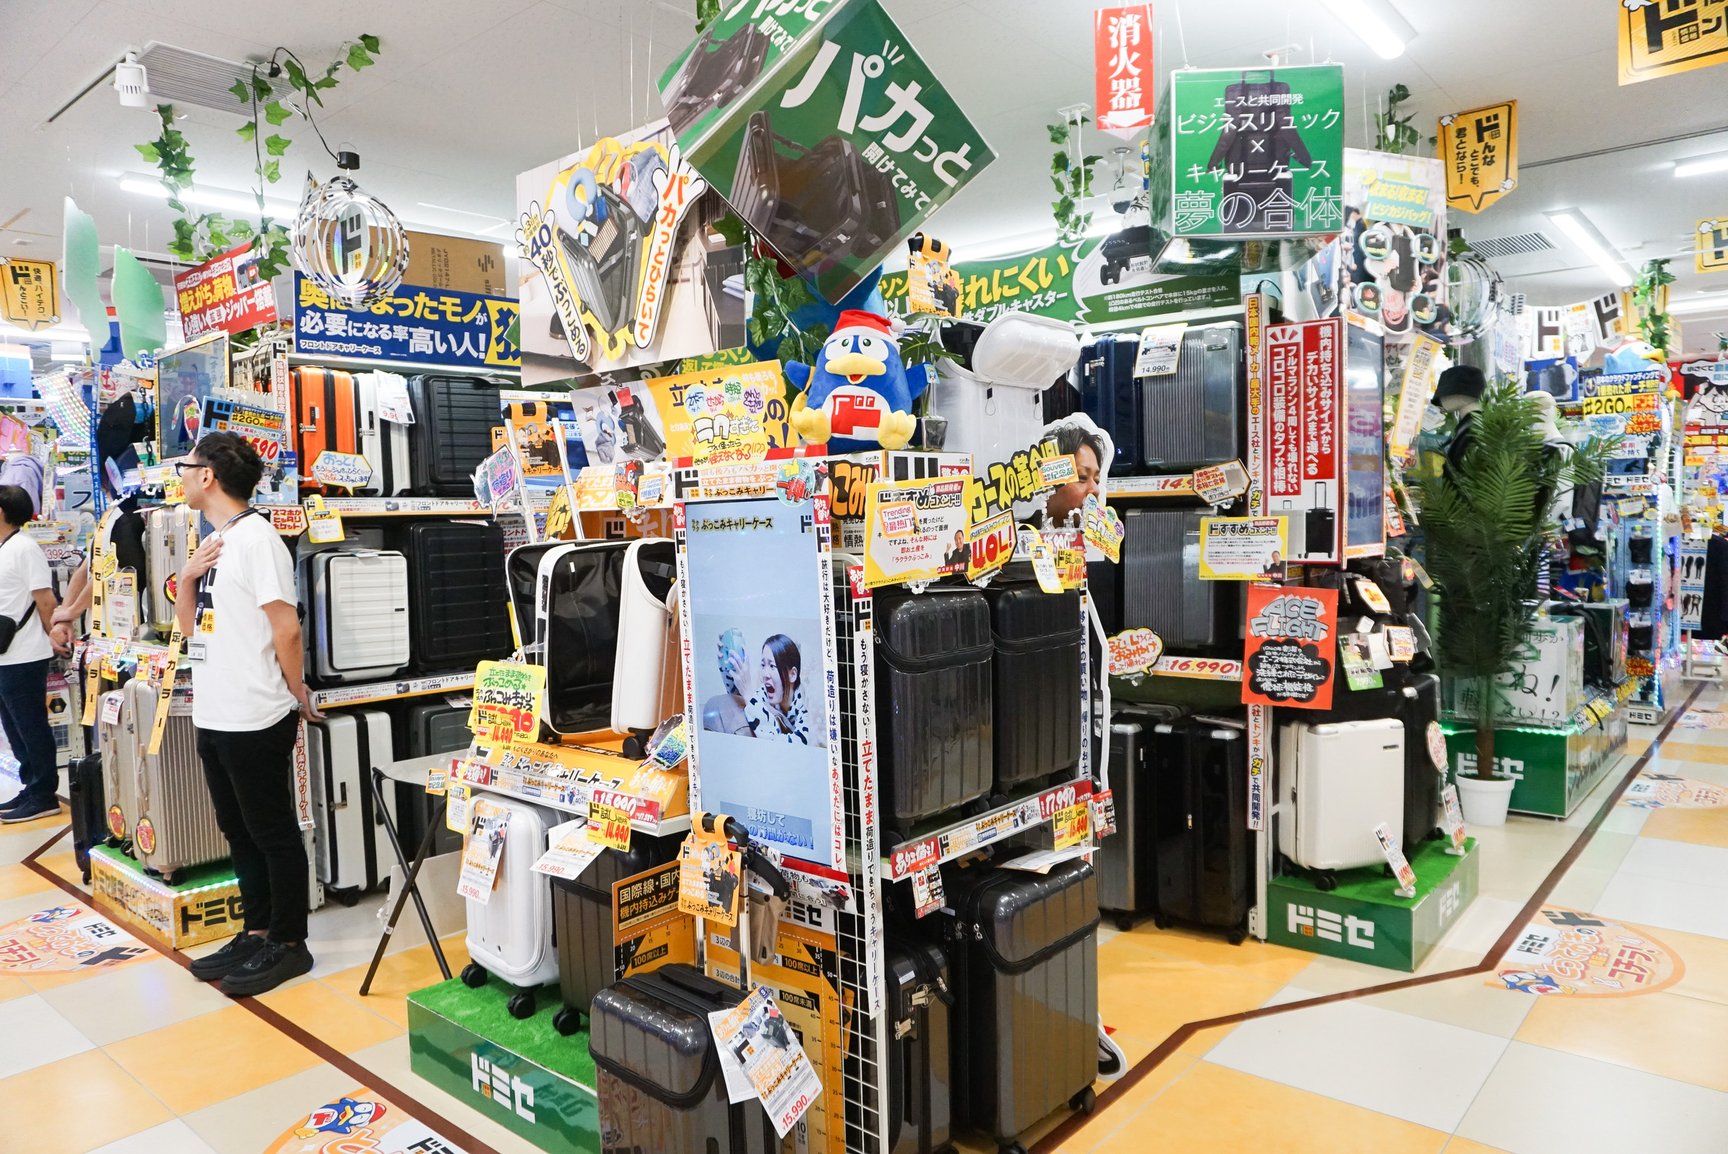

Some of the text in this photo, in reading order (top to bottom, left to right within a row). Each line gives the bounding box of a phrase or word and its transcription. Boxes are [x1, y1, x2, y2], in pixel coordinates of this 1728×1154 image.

[1109, 14, 1142, 110] 消火器
[780, 39, 972, 188] パカっと
[1213, 93, 1304, 107] エースと共同開発
[1177, 109, 1341, 135] ビジネスリュック
[1186, 160, 1331, 183] キャリーケース
[1174, 186, 1342, 232] 夢の合体
[637, 172, 690, 342] パカっとひらいて
[300, 310, 486, 359] 必要になる率高い人!
[1319, 325, 1334, 455] 機内持ち込みサイズから
[701, 516, 774, 532] ぶっこみキャリーケース
[882, 506, 912, 518] Trending
[1250, 615, 1329, 641] FLIGHT
[1262, 597, 1320, 620] ACE
[1287, 903, 1375, 949] ドミセ
[470, 1052, 537, 1125] ドミセ
[782, 1094, 808, 1128] 15,990
